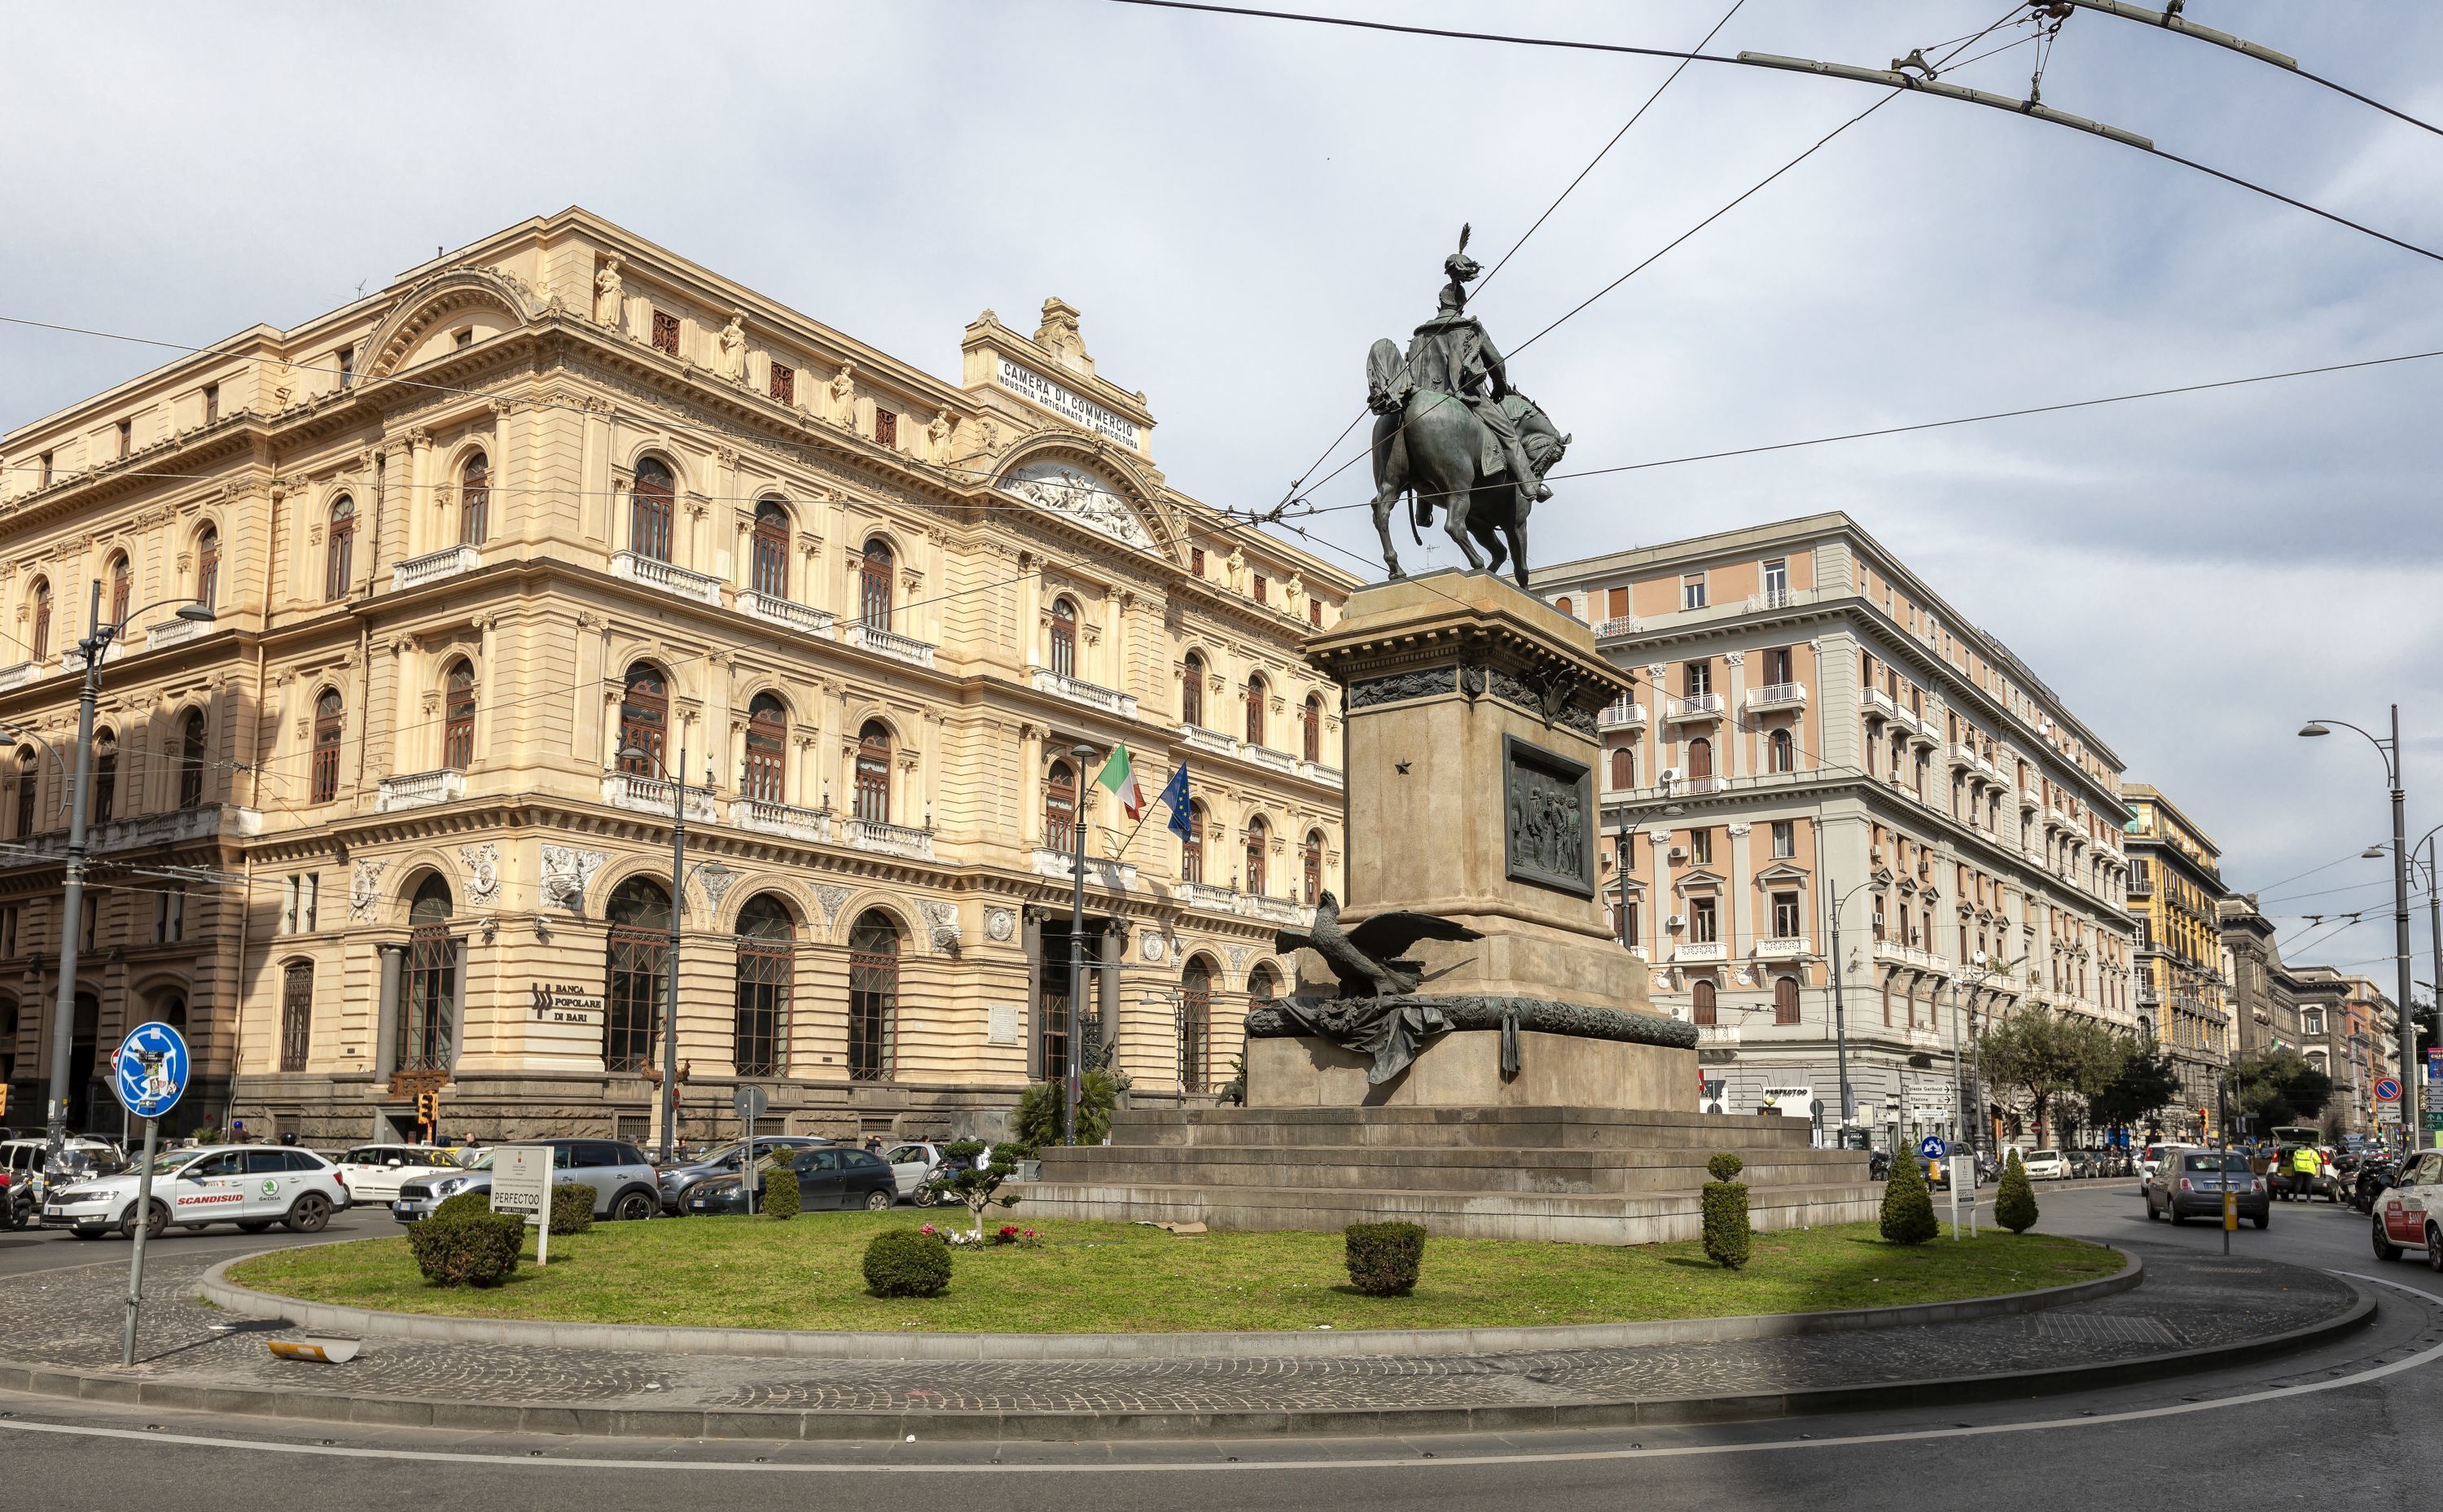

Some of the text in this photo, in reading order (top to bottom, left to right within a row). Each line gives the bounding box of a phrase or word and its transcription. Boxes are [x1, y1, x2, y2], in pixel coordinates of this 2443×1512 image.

[1004, 363, 1133, 437] CAMERA DI COMMERCIO
[997, 374, 1138, 450] INDUSTRIA ARTIGIANATO E AGRICOLTURA
[555, 984, 585, 994] BANCA
[555, 997, 602, 1009] POPOLARE
[554, 1012, 587, 1023] DI BARI
[178, 1194, 243, 1205] SCANDISUD
[495, 1193, 539, 1205] PERFECTOO
